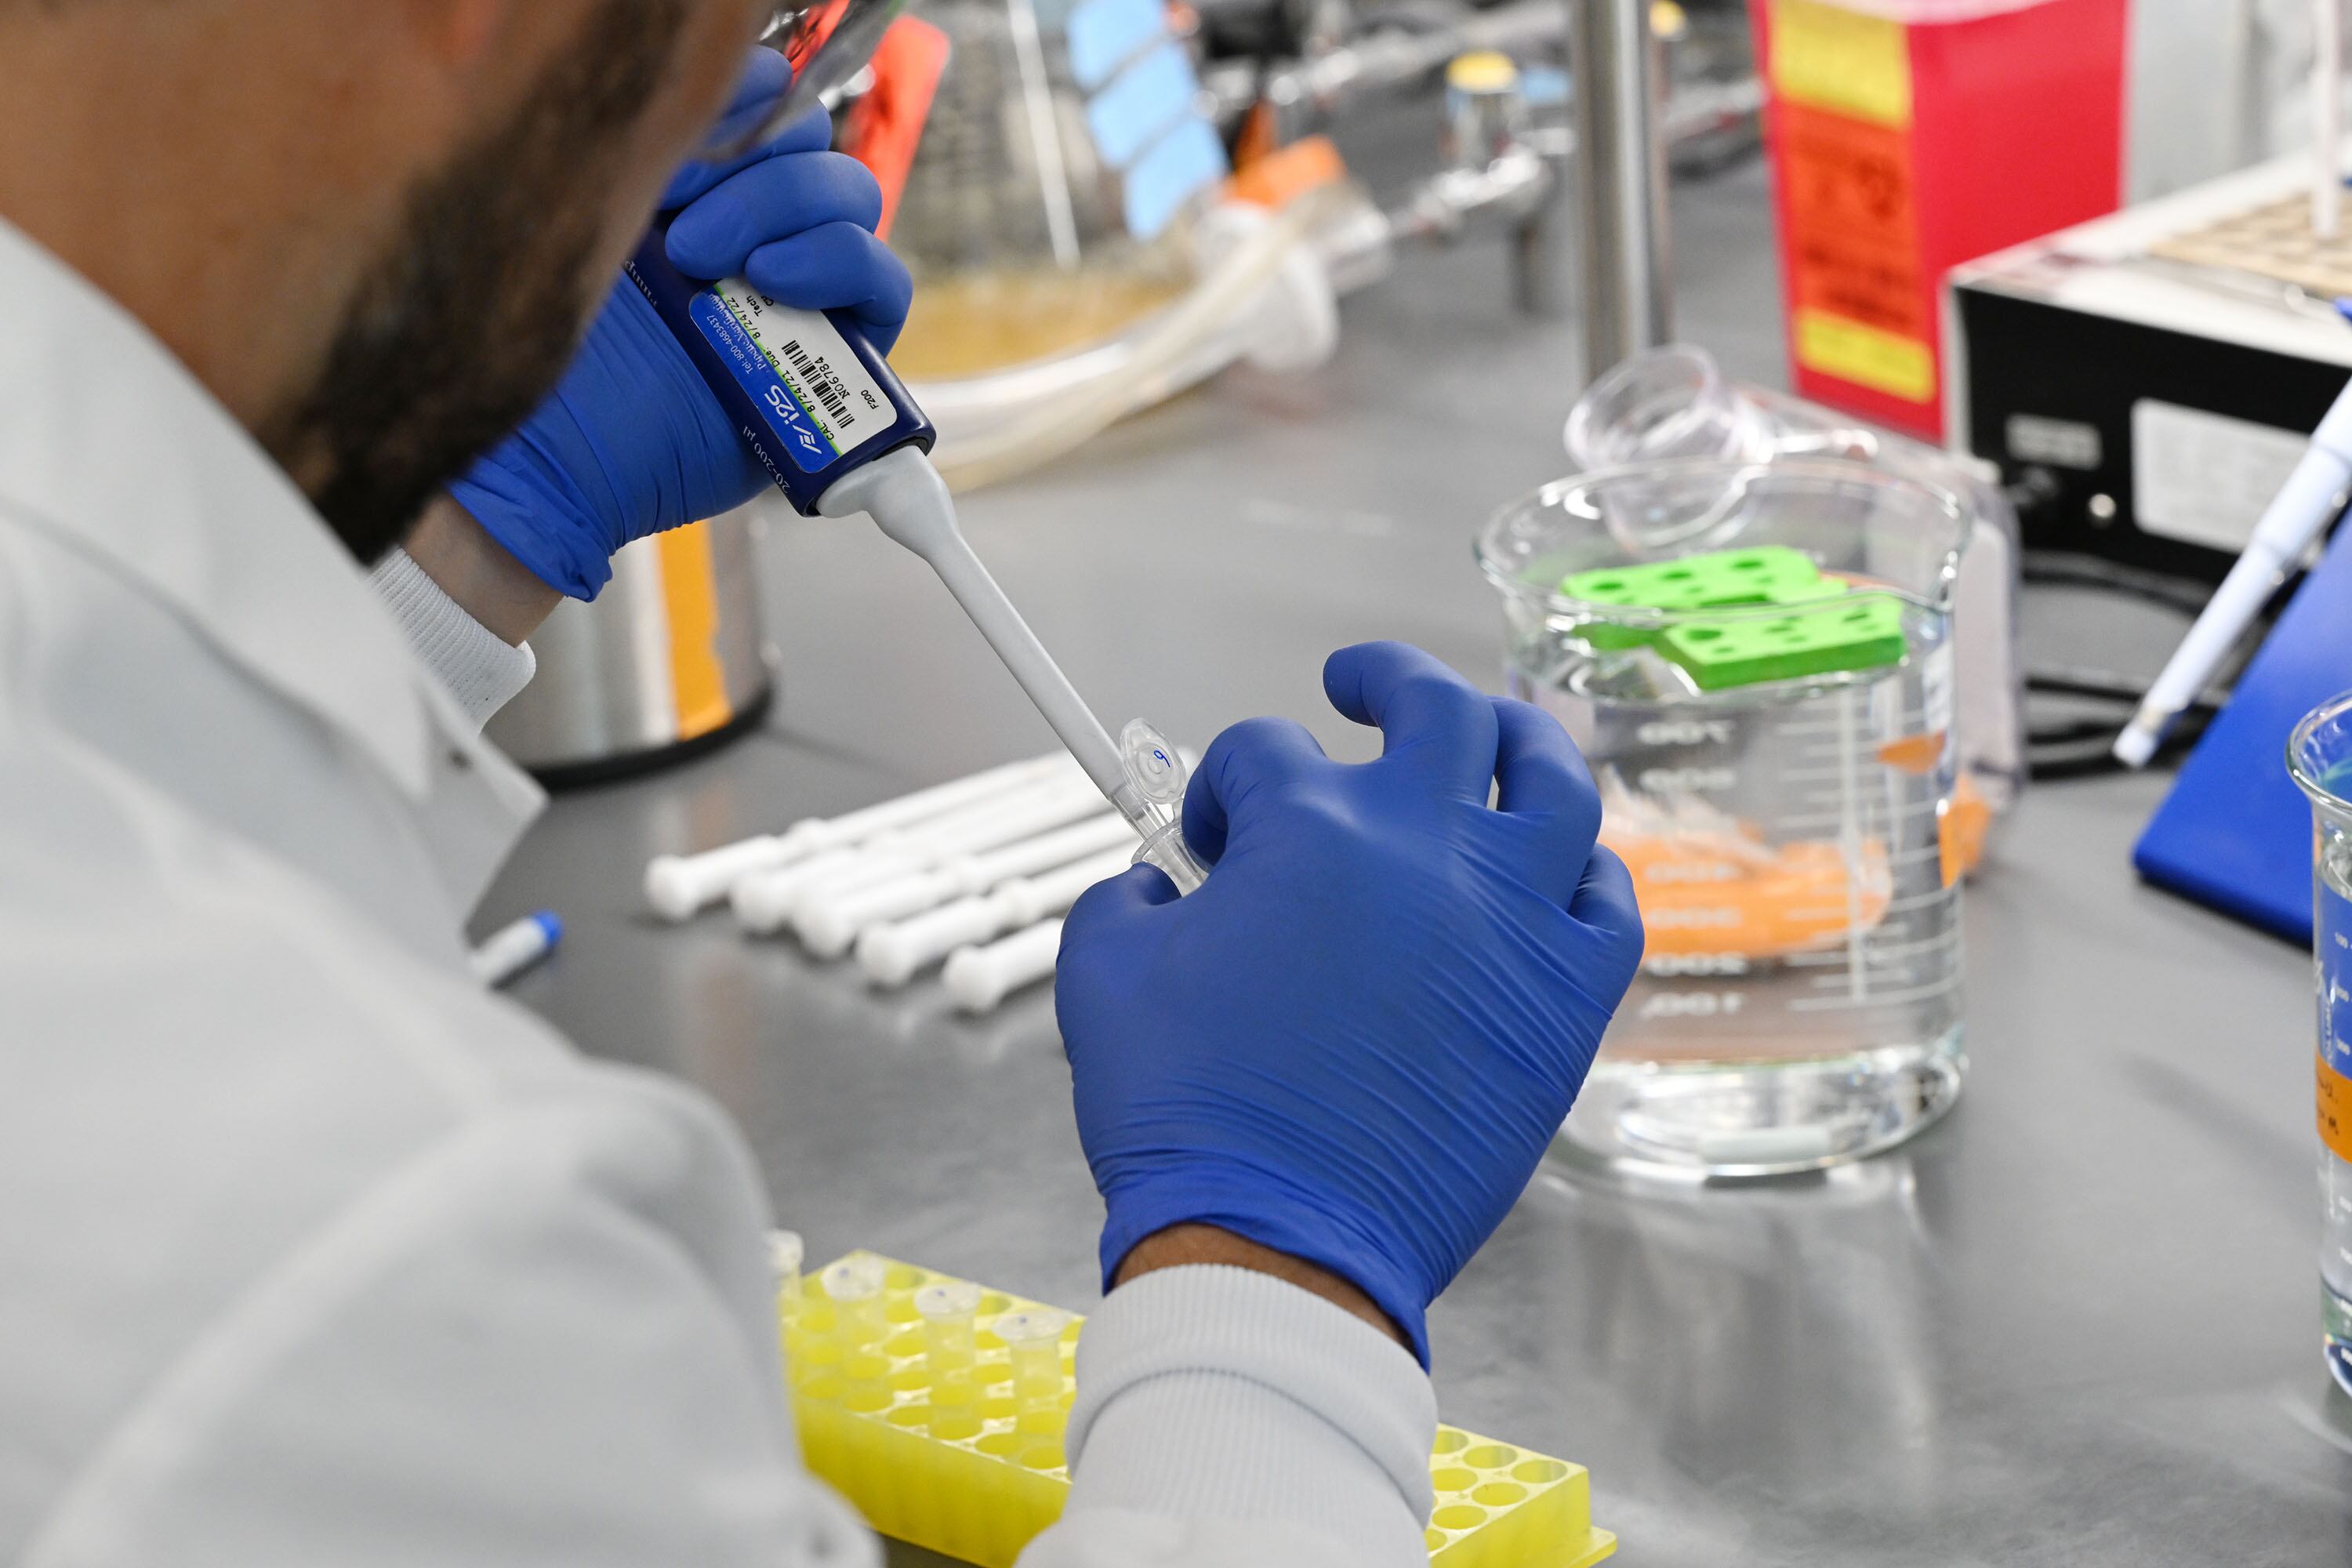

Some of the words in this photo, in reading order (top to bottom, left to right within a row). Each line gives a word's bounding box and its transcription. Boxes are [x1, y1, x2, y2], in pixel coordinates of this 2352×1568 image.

[746, 294, 764, 317] Tech
[726, 296, 761, 342] 8/24/22
[706, 313, 745, 361] 800-4683437
[740, 358, 754, 375] Tel:
[762, 347, 781, 370] Due:
[781, 369, 816, 415] 8/24/21
[860, 388, 879, 410] F200
[815, 419, 835, 442] CAL:
[752, 441, 791, 495] 20-200
